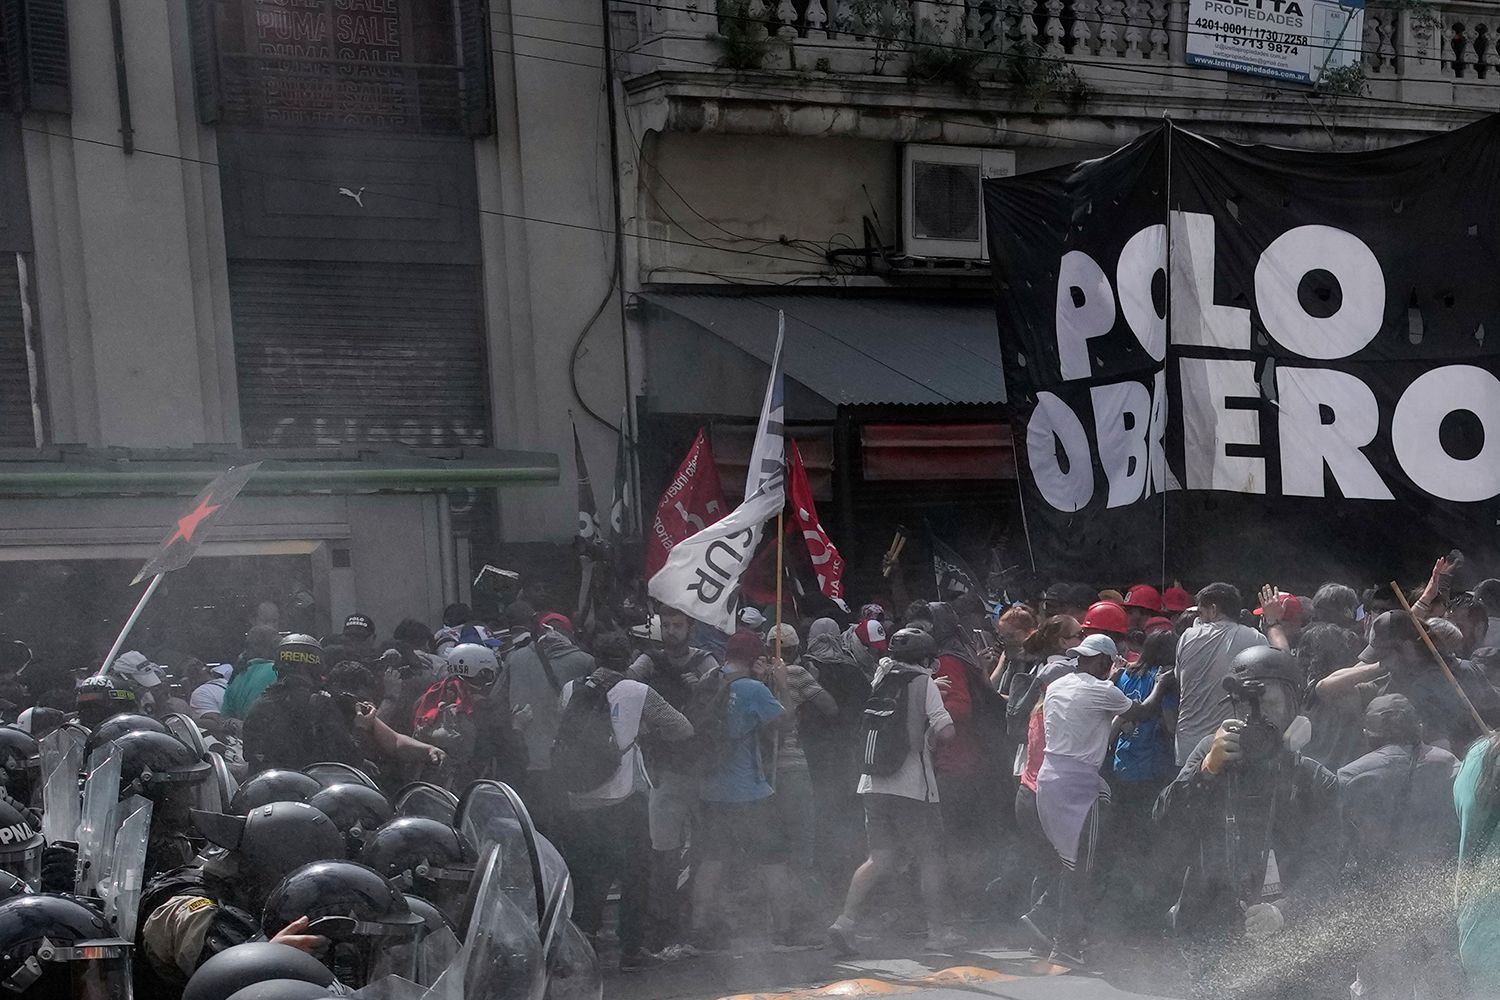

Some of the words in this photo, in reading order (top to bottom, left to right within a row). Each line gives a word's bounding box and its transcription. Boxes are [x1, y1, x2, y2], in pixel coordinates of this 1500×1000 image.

[1205, 1, 1303, 28] PROPIEDADES
[257, 12, 331, 42] PUMA
[336, 14, 400, 47] SALE
[1268, 42, 1298, 55] 9874
[1056, 210, 1386, 381] POLO
[280, 650, 321, 665] PRENSA
[0, 822, 34, 845] PNA
